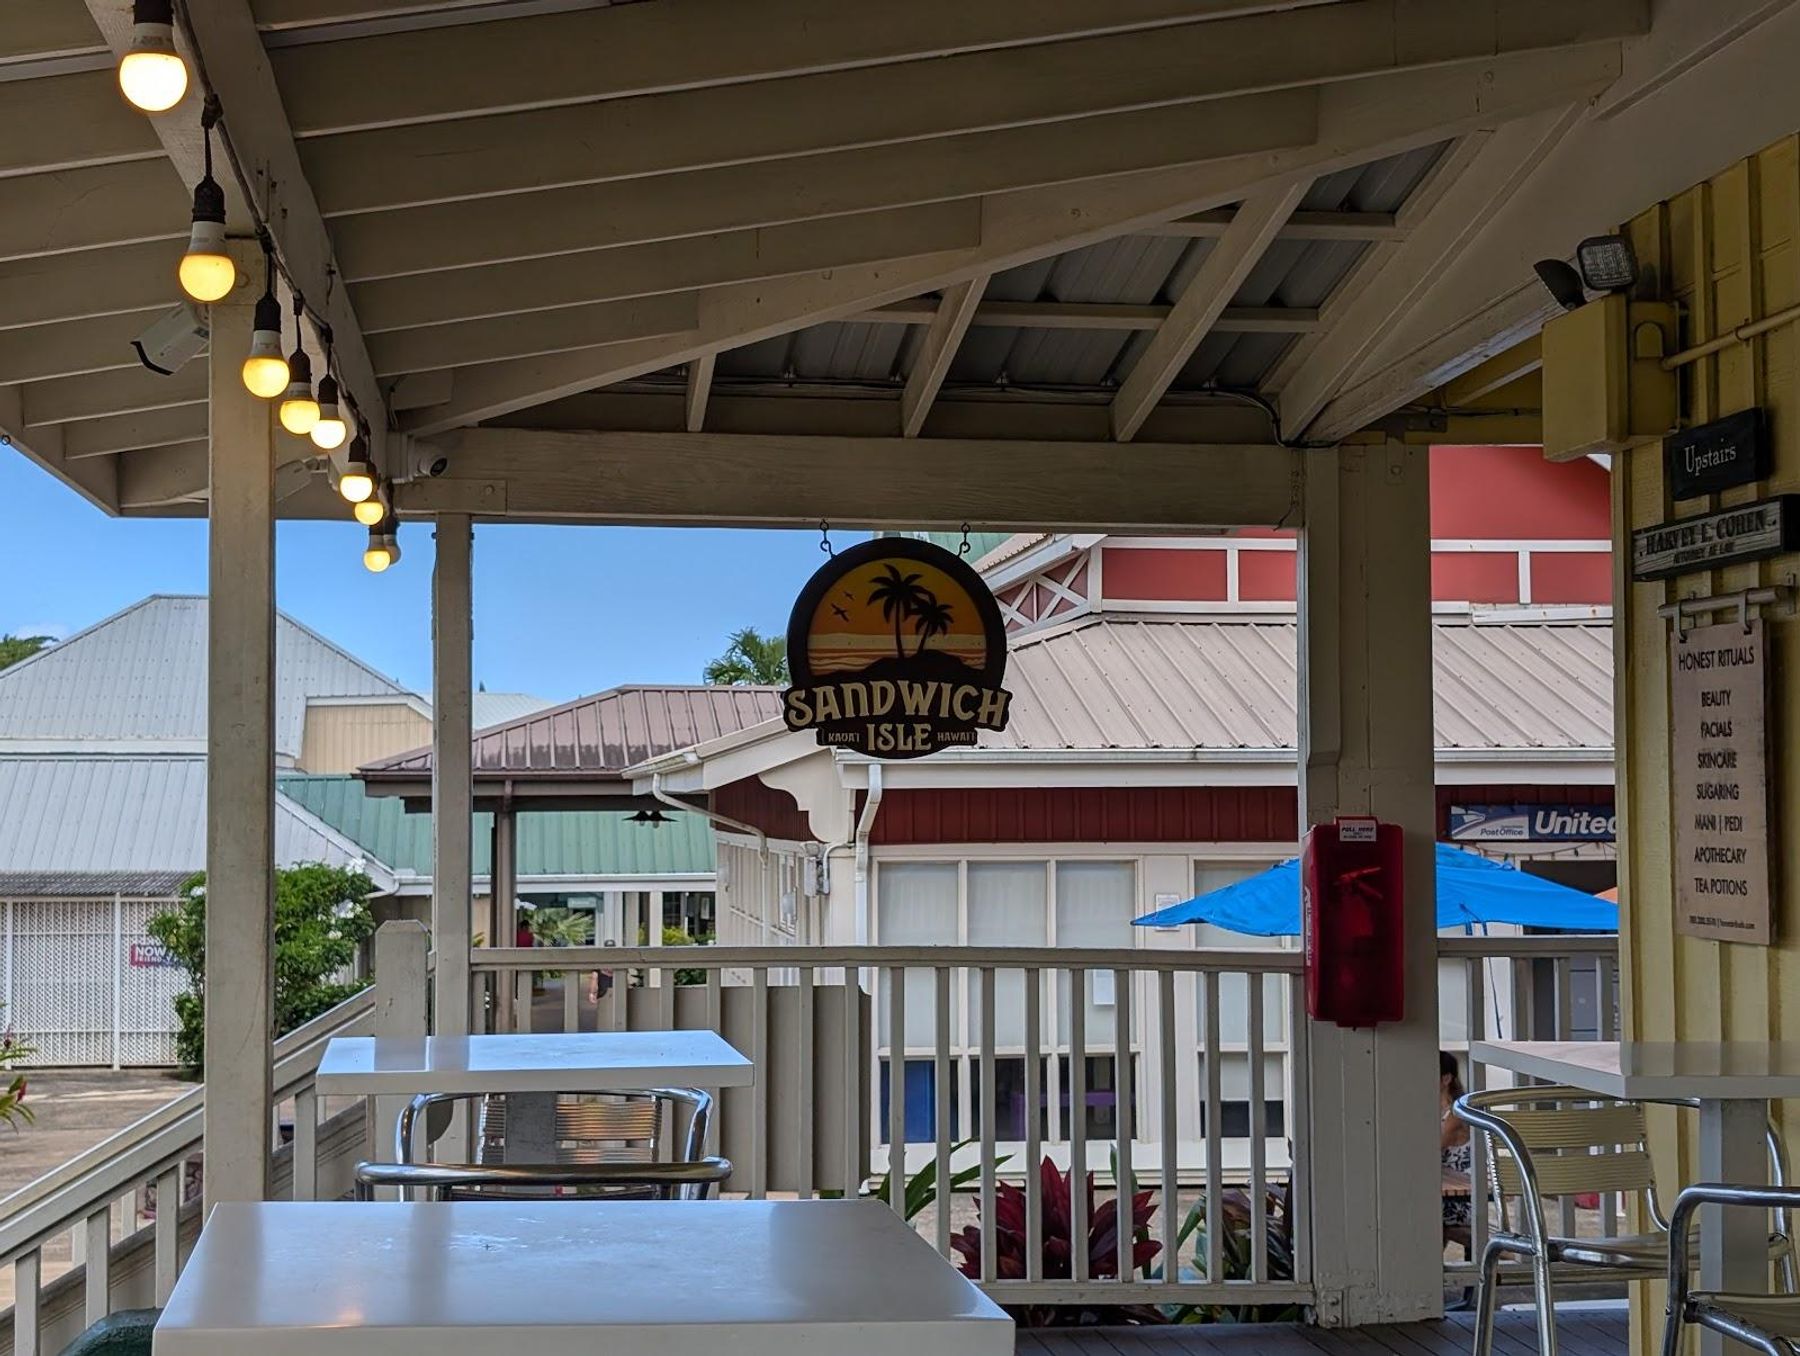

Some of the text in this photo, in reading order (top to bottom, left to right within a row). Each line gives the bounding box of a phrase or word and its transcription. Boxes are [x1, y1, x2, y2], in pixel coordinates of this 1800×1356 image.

[1685, 444, 1737, 476] Upstairs
[1646, 526, 1697, 555] HARVEY
[1716, 509, 1766, 539] COHEN
[1679, 647, 1755, 671] HONEST RITUALS
[788, 679, 1009, 728] SANDWICH
[1702, 690, 1731, 707] BEAUTY
[866, 723, 932, 751] ISLE
[1701, 721, 1732, 738] FACIALS
[1698, 752, 1737, 769] SKINCARE
[1697, 783, 1739, 800] SUGARING
[1480, 828, 1524, 836] Post Office
[1695, 815, 1716, 830] MANI
[1724, 816, 1743, 832] PEDI
[1694, 848, 1746, 864] APOTHECARY
[1694, 877, 1747, 896] TEA POTIONS
[136, 946, 167, 956] NOW
